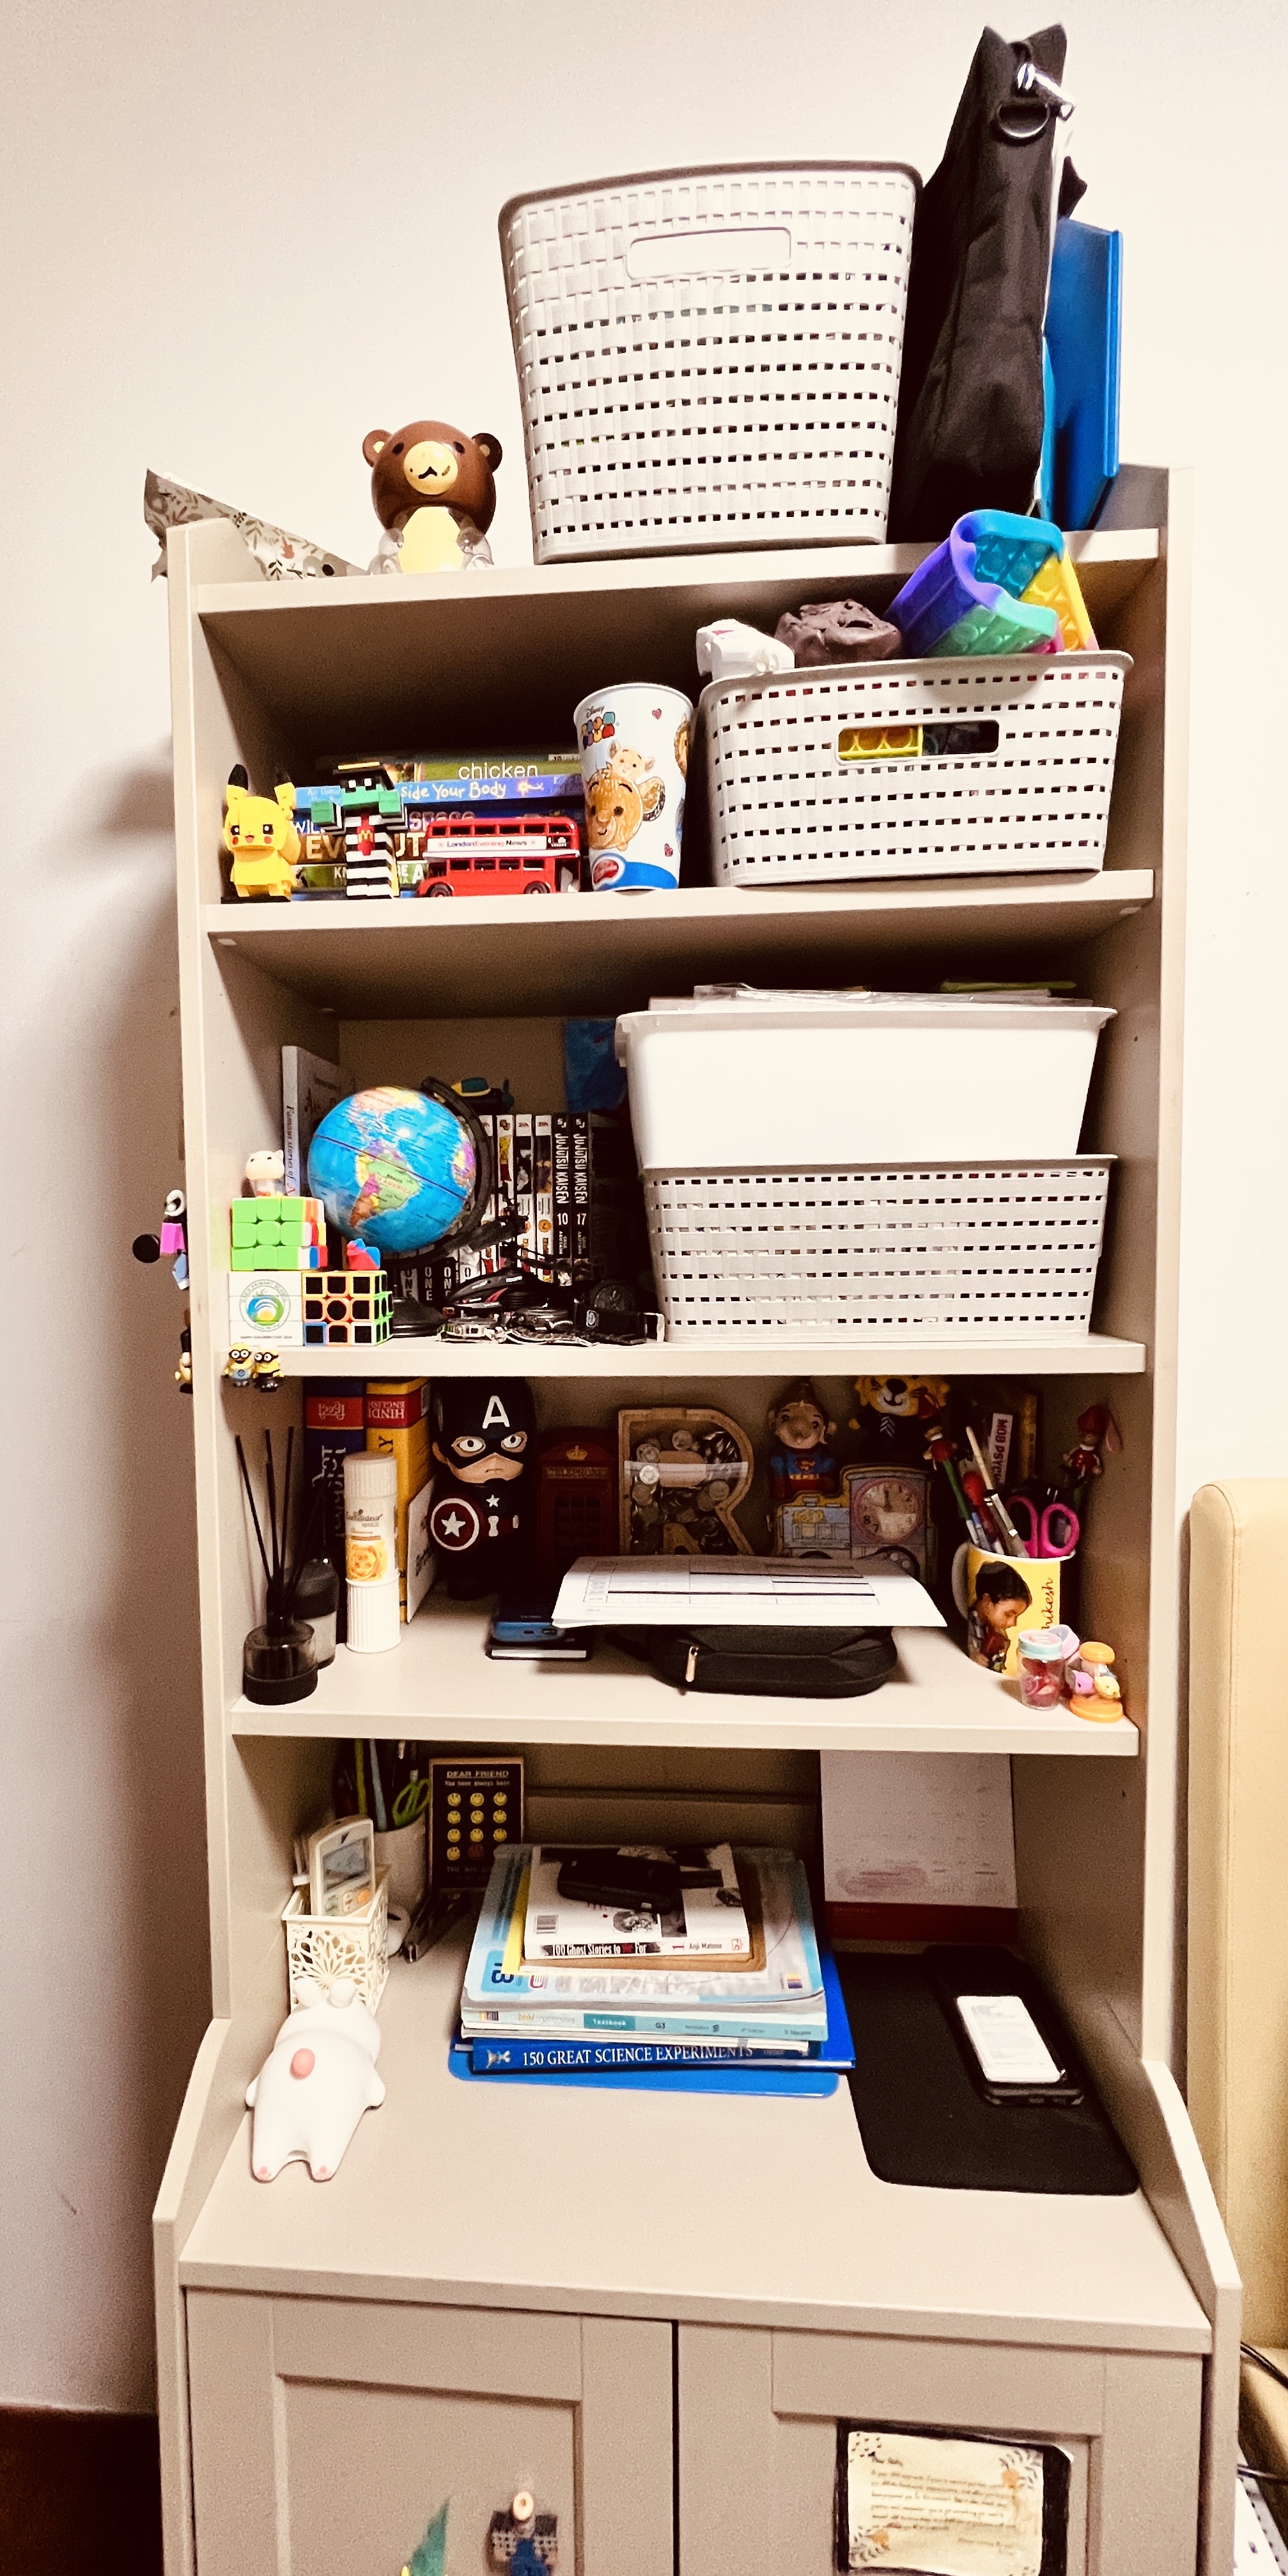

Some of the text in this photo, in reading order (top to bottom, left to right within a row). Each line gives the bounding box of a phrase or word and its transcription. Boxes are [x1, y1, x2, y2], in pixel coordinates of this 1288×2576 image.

[458, 762, 538, 780] chicken
[401, 781, 506, 801] side Your Body
[286, 1105, 295, 1139] Famous
[555, 1133, 569, 1204] JUJUTSU KAISEN
[573, 1133, 588, 1204] JUJUTSU KAISEN
[557, 1212, 568, 1225] 10
[576, 1213, 587, 1225] 17
[424, 1267, 433, 1301] ONE
[368, 1408, 405, 1419] HINDI
[482, 1395, 510, 1429] A
[991, 1419, 1007, 1480] MOB PSYCH
[552, 1945, 566, 1956] 100
[566, 1944, 587, 1956] Ghost
[587, 1943, 613, 1955] Stories
[523, 2045, 753, 2066] 150 GREAT SCIENCE EXPERIMENTS
